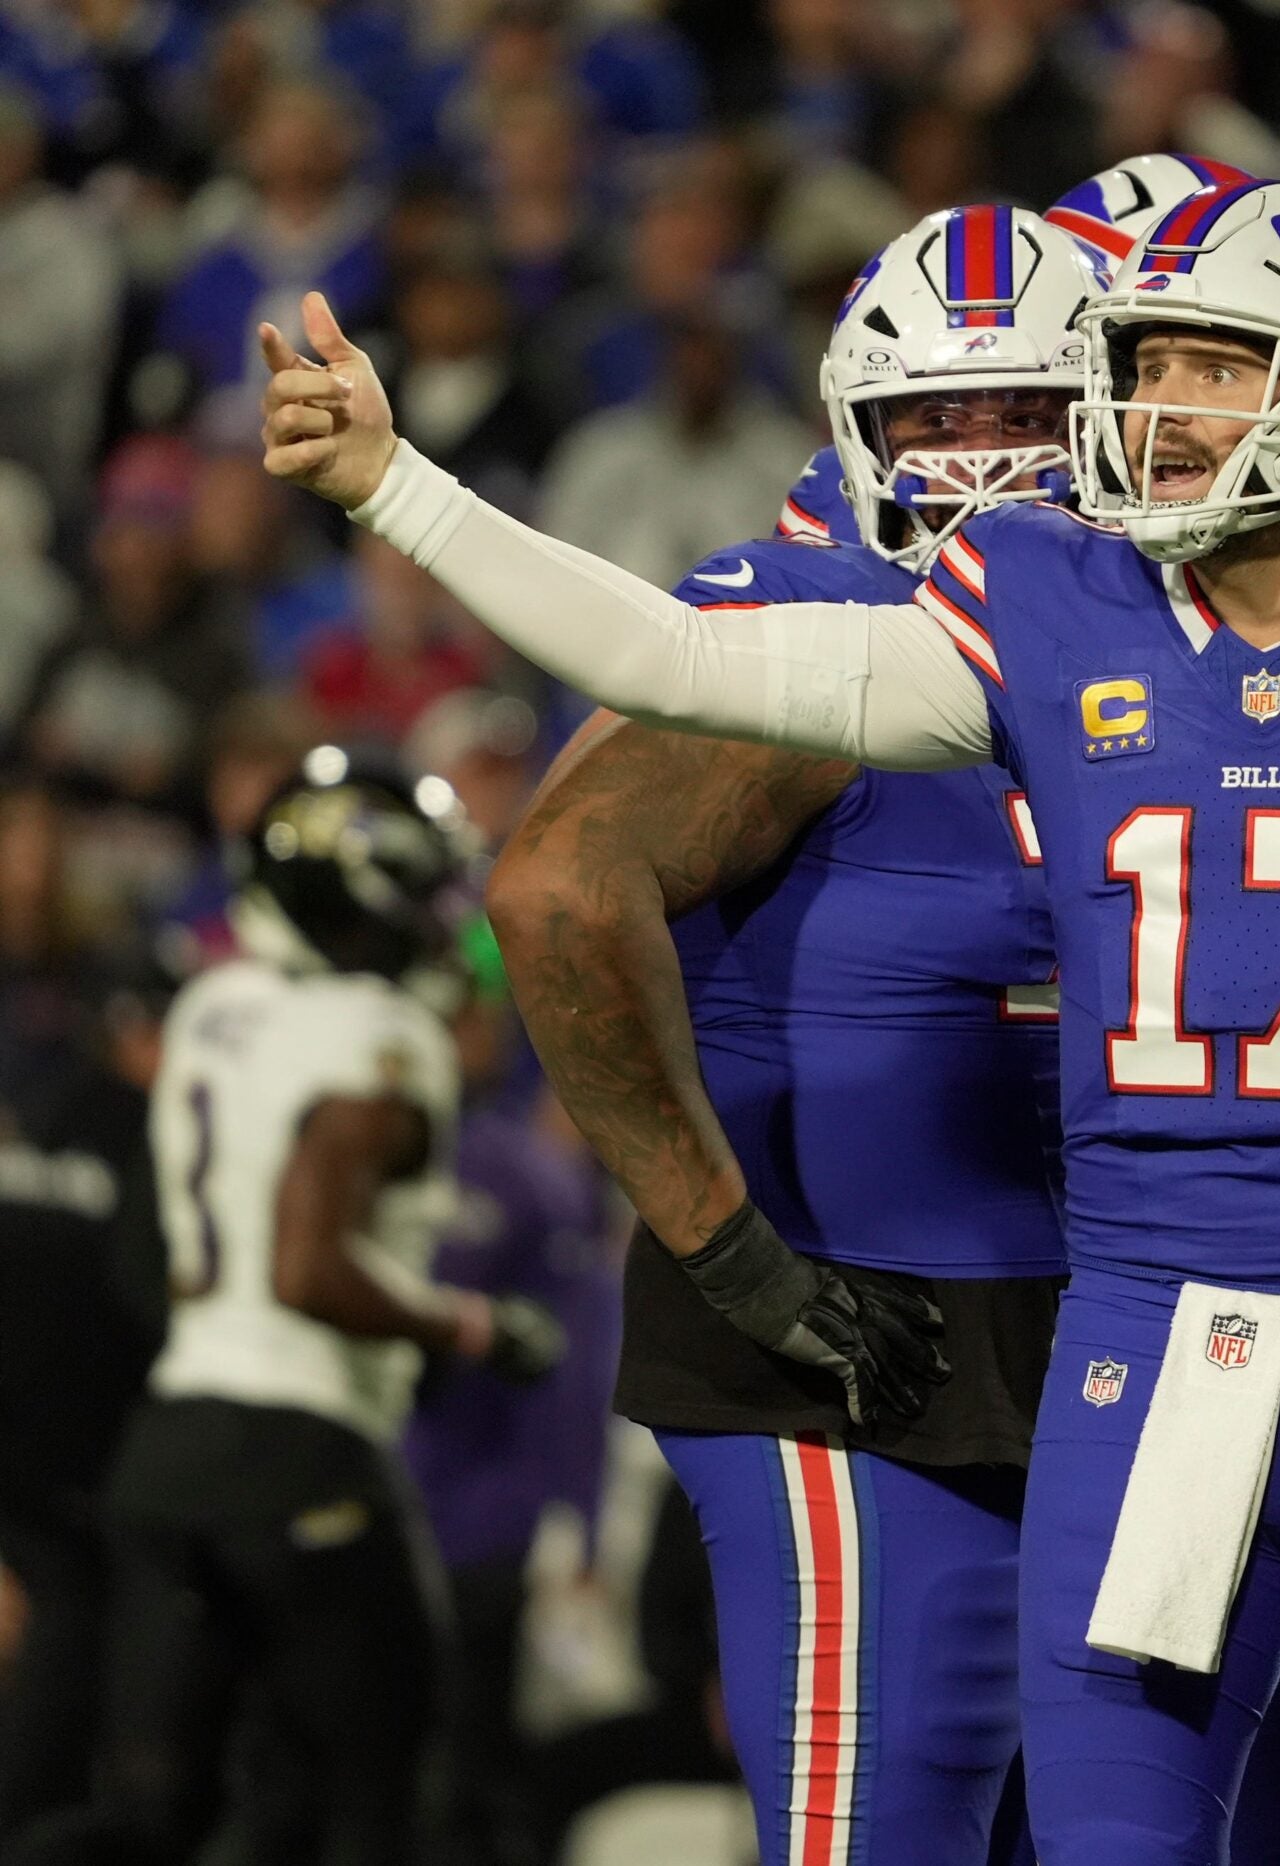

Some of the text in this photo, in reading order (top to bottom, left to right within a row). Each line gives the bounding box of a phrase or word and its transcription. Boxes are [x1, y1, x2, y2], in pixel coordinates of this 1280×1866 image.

[1080, 679, 1147, 736] C
[1249, 694, 1276, 712] NFL
[1209, 1335, 1247, 1366] NFL
[1090, 1379, 1116, 1397] NFL
